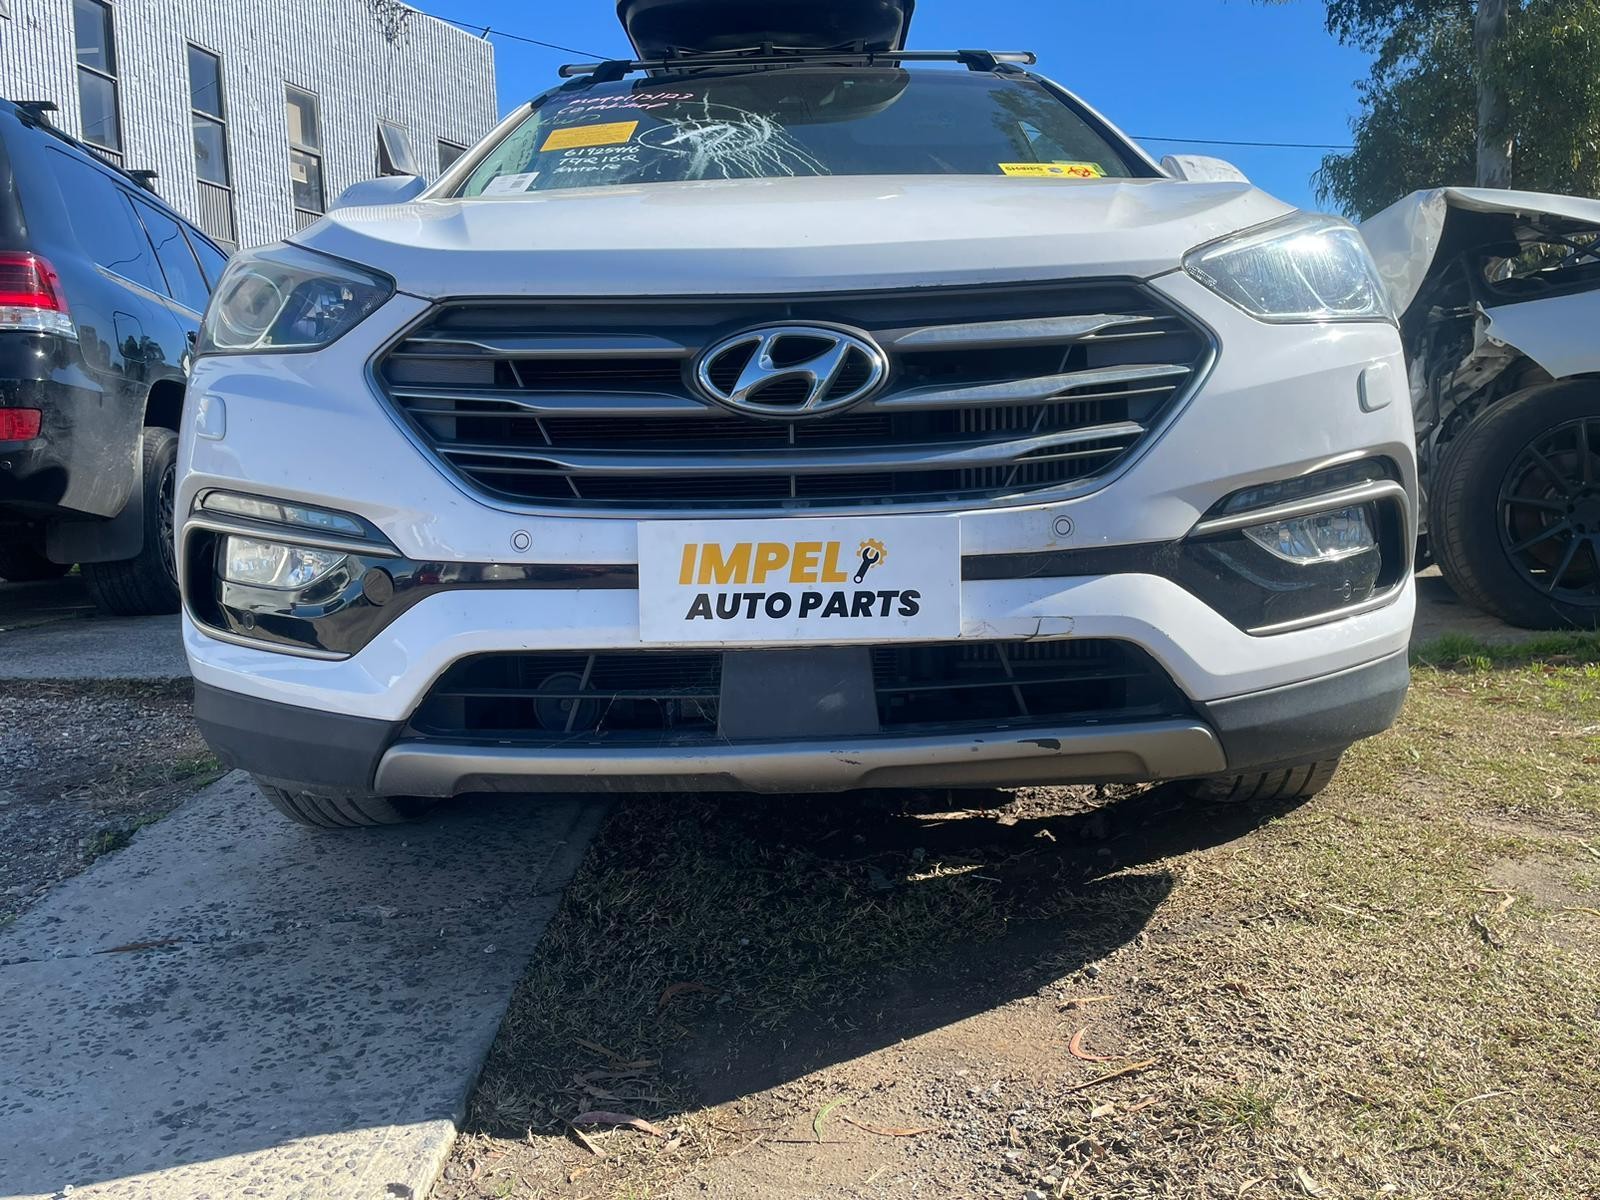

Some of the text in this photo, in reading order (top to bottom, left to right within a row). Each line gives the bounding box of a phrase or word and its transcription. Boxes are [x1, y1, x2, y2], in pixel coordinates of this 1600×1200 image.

[678, 541, 848, 585] IMPEL
[685, 590, 921, 620] AUTO PARTS
